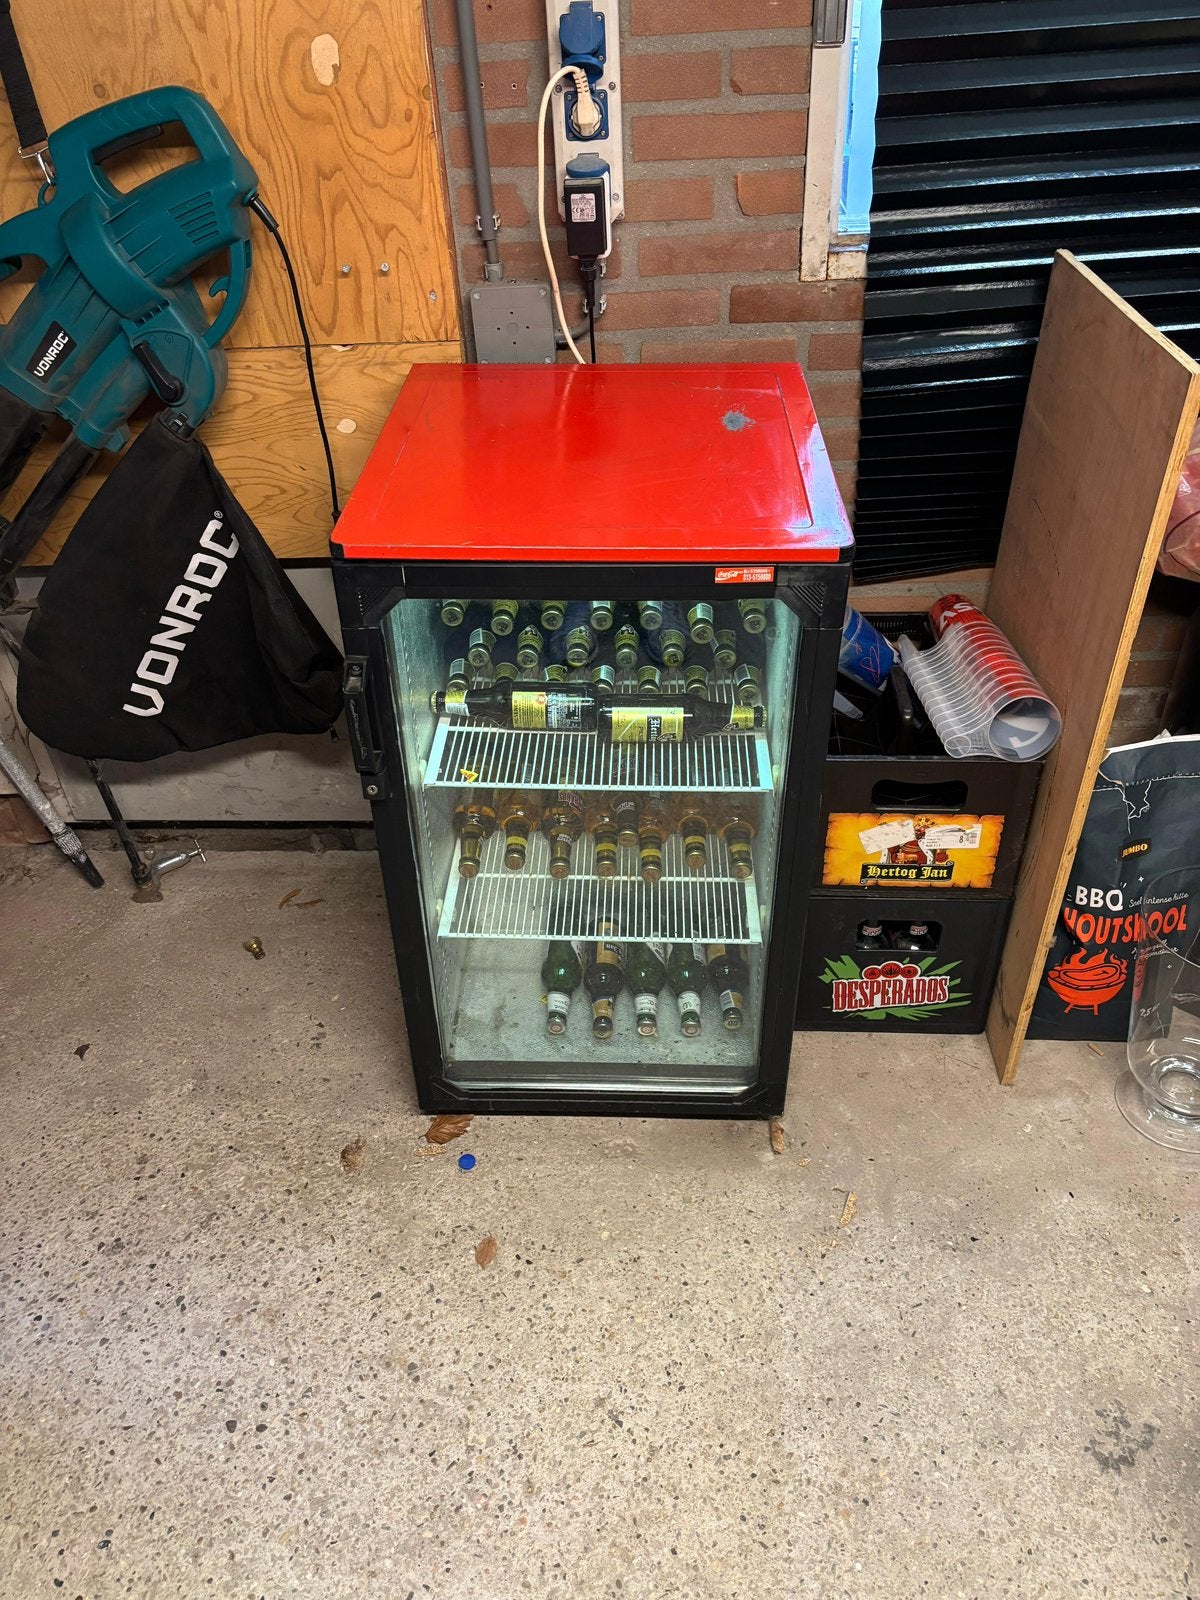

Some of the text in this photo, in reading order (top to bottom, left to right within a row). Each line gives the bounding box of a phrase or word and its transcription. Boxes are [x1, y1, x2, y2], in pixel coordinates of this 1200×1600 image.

[33, 332, 69, 377] VONROC
[122, 519, 240, 717] VONROC
[1121, 843, 1149, 858] JUMBO
[867, 865, 948, 879] Hertog Jan
[1075, 885, 1124, 911] BBQ
[833, 976, 950, 1011] DESPERADOS
